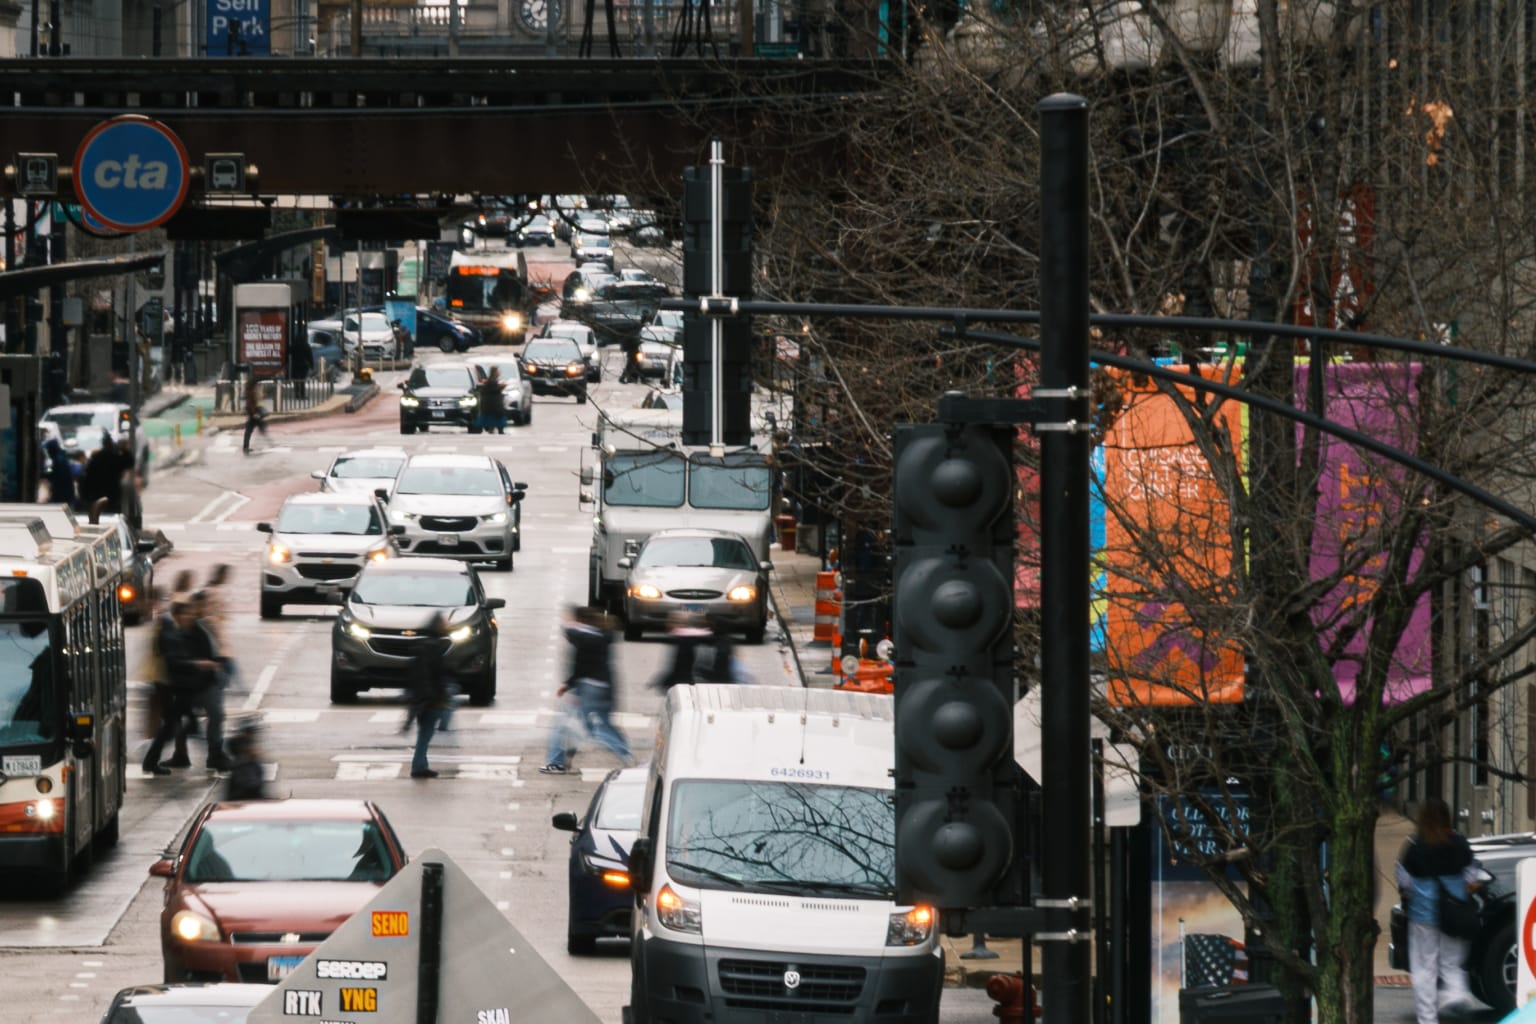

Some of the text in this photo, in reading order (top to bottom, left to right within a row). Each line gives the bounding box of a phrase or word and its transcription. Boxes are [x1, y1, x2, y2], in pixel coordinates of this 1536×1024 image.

[212, 15, 263, 35] Prk
[94, 154, 168, 189] cta
[770, 767, 831, 780] 6426931
[372, 912, 408, 936] SENO
[285, 990, 321, 1015] RTK
[341, 987, 377, 1011] YNG
